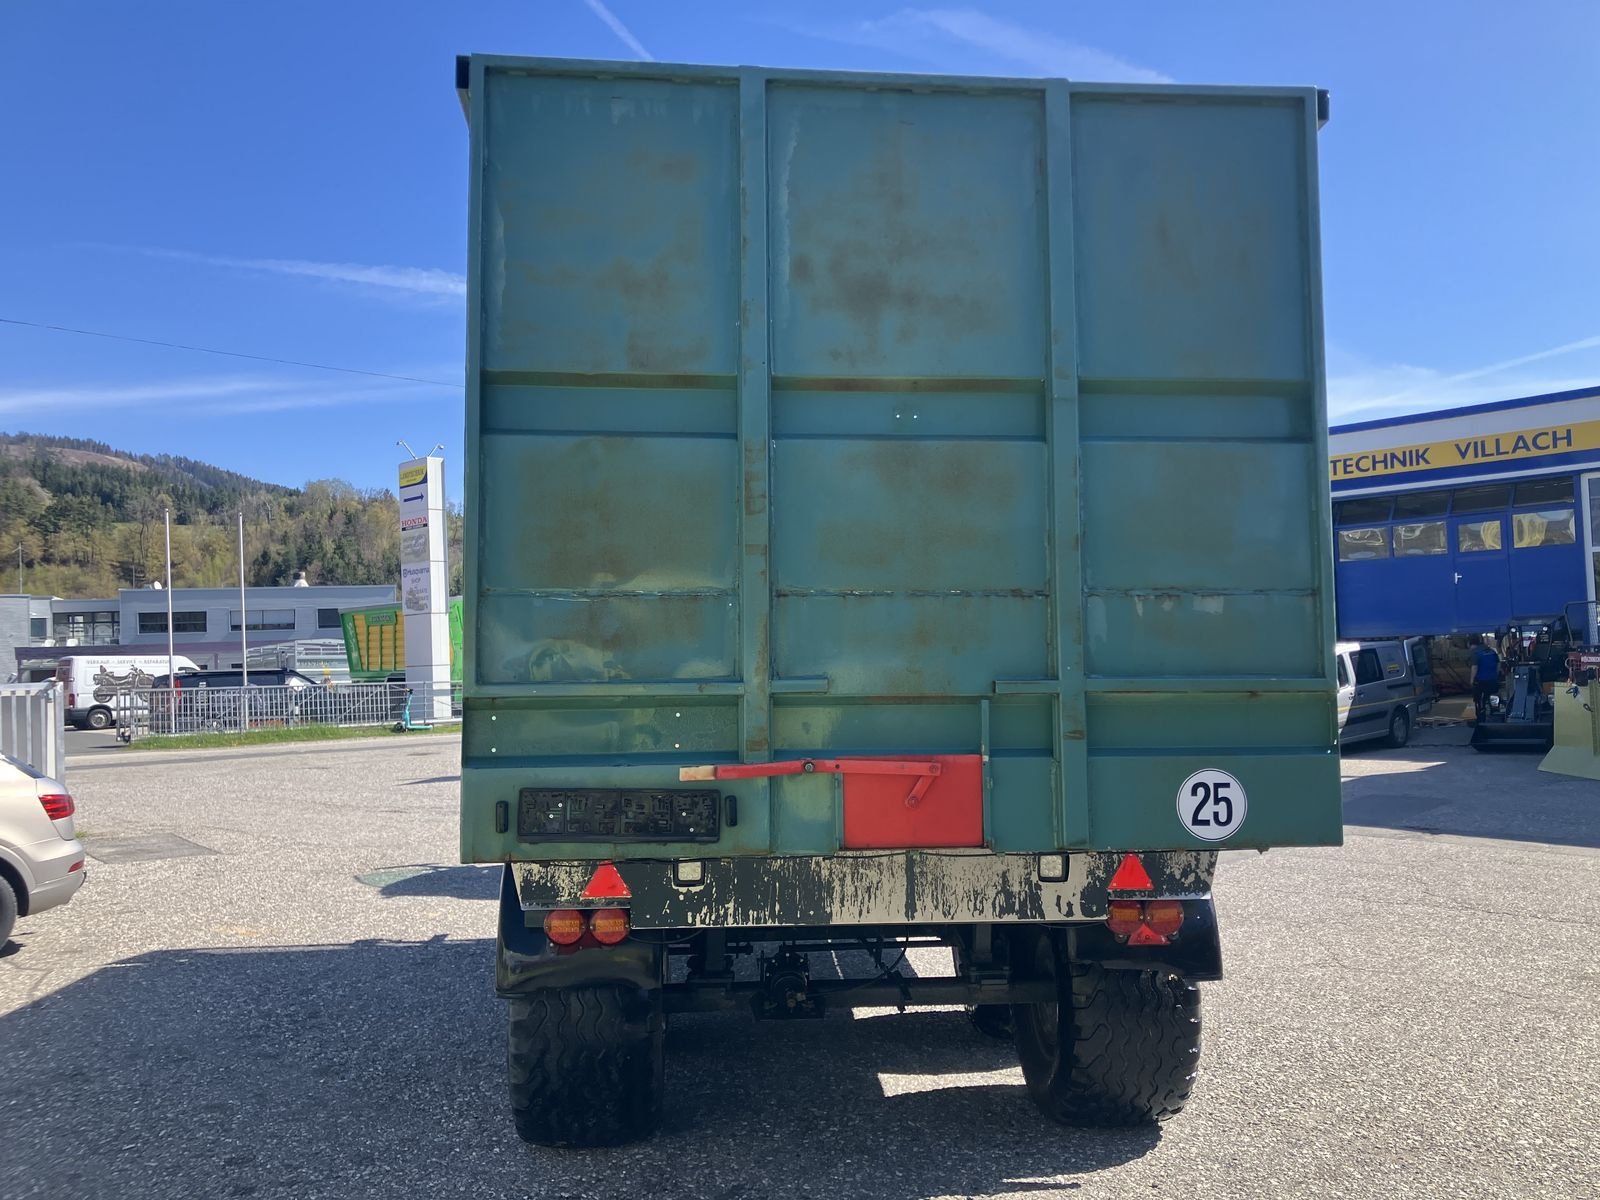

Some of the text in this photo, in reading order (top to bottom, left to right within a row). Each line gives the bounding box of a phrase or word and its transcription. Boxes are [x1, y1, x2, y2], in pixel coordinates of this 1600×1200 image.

[1330, 428, 1573, 476] TECHNIK VILLACH
[401, 516, 428, 527] HONDA
[1190, 781, 1233, 827] 25
